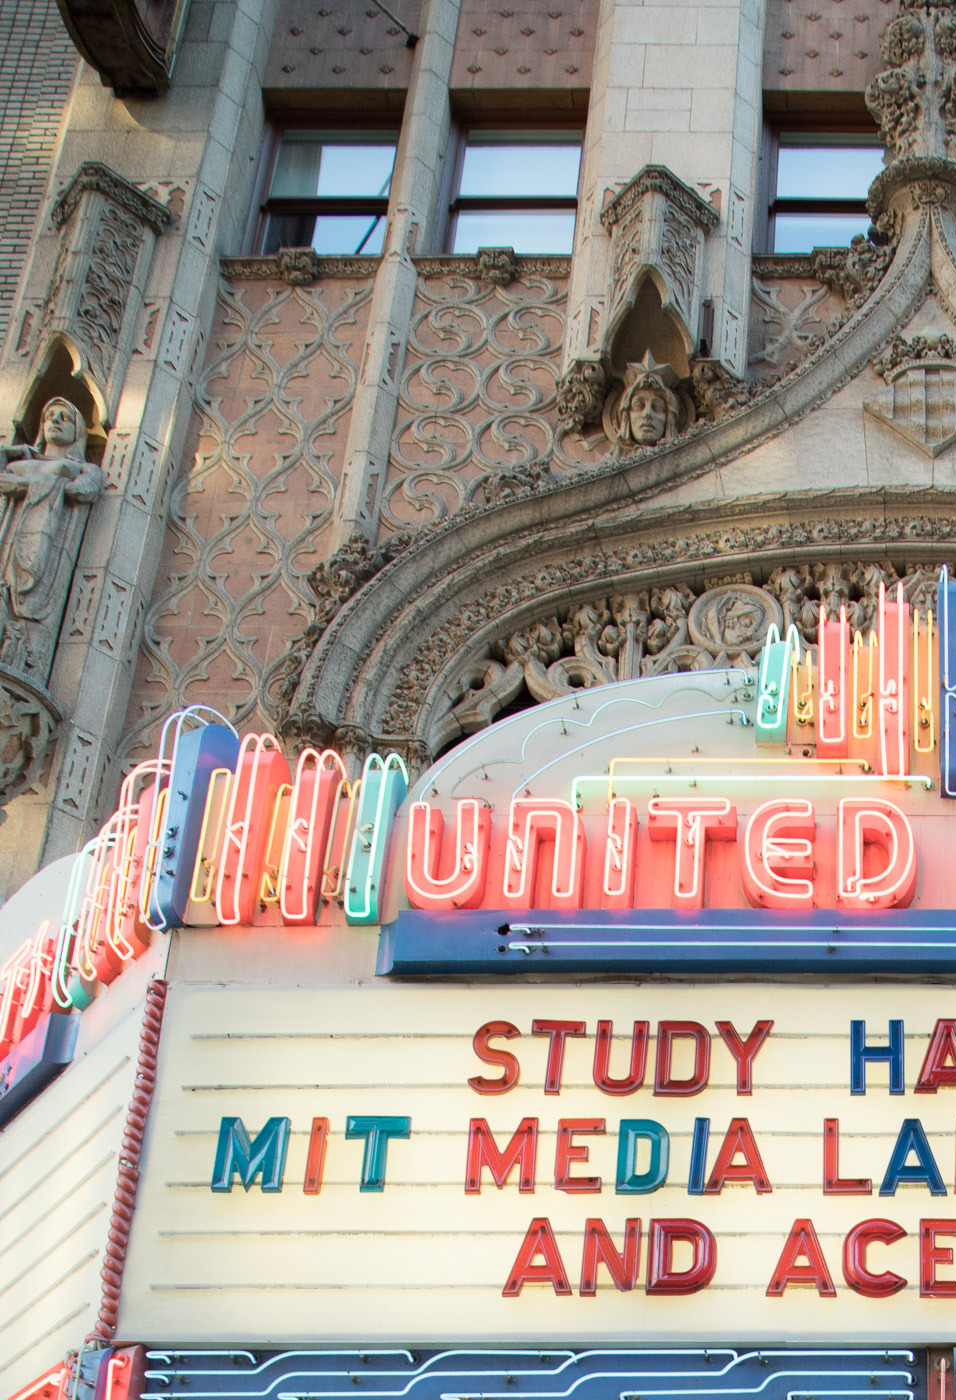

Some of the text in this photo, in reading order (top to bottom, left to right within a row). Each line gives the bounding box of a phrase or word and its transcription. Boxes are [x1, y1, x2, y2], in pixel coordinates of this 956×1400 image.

[404, 798, 918, 910] UNITED
[467, 1019, 774, 1098] STUDY
[211, 1116, 412, 1195] MIT
[464, 1116, 773, 1196] MEDIA
[502, 1217, 718, 1298] AND
